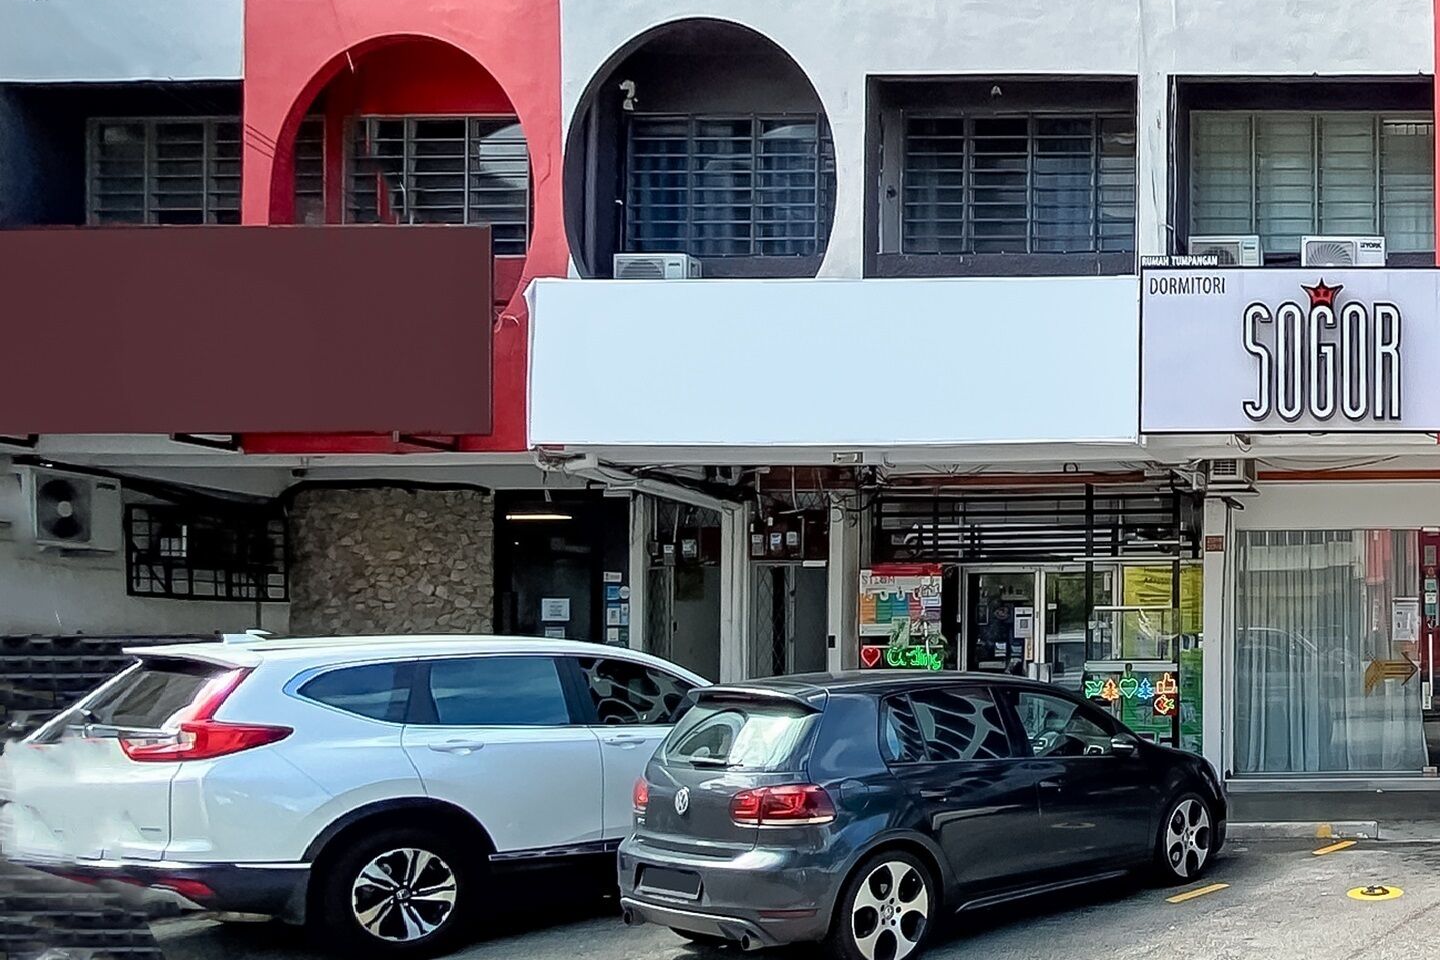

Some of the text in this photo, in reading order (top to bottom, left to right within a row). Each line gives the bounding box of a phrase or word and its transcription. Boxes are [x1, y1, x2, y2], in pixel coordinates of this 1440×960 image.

[1141, 255, 1218, 266] RUMAH TUMPANGAN
[1150, 277, 1225, 295] DORMITORI
[1243, 301, 1402, 422] SOGOR
